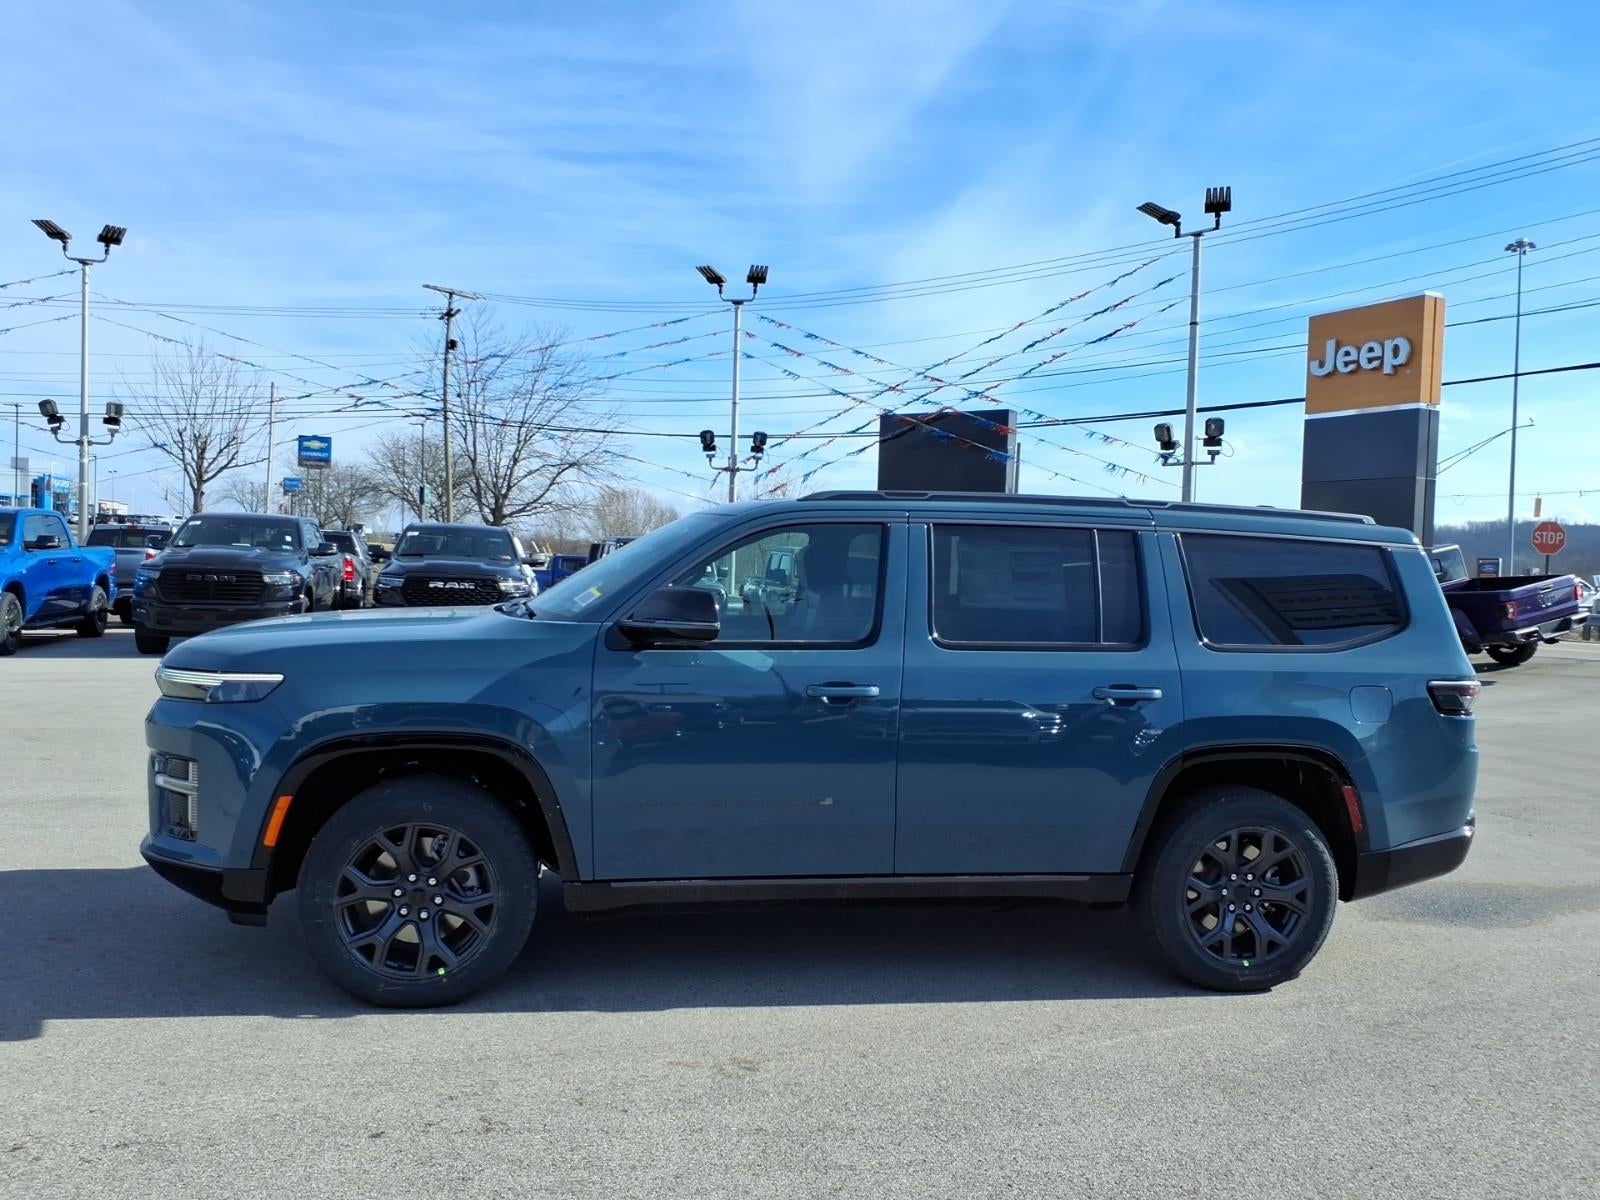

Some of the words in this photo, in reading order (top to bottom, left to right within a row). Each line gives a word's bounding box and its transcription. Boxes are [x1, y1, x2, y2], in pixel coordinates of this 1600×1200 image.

[1310, 336, 1411, 377] Jeep
[1533, 531, 1564, 545] STOP
[428, 581, 476, 589] RAM
